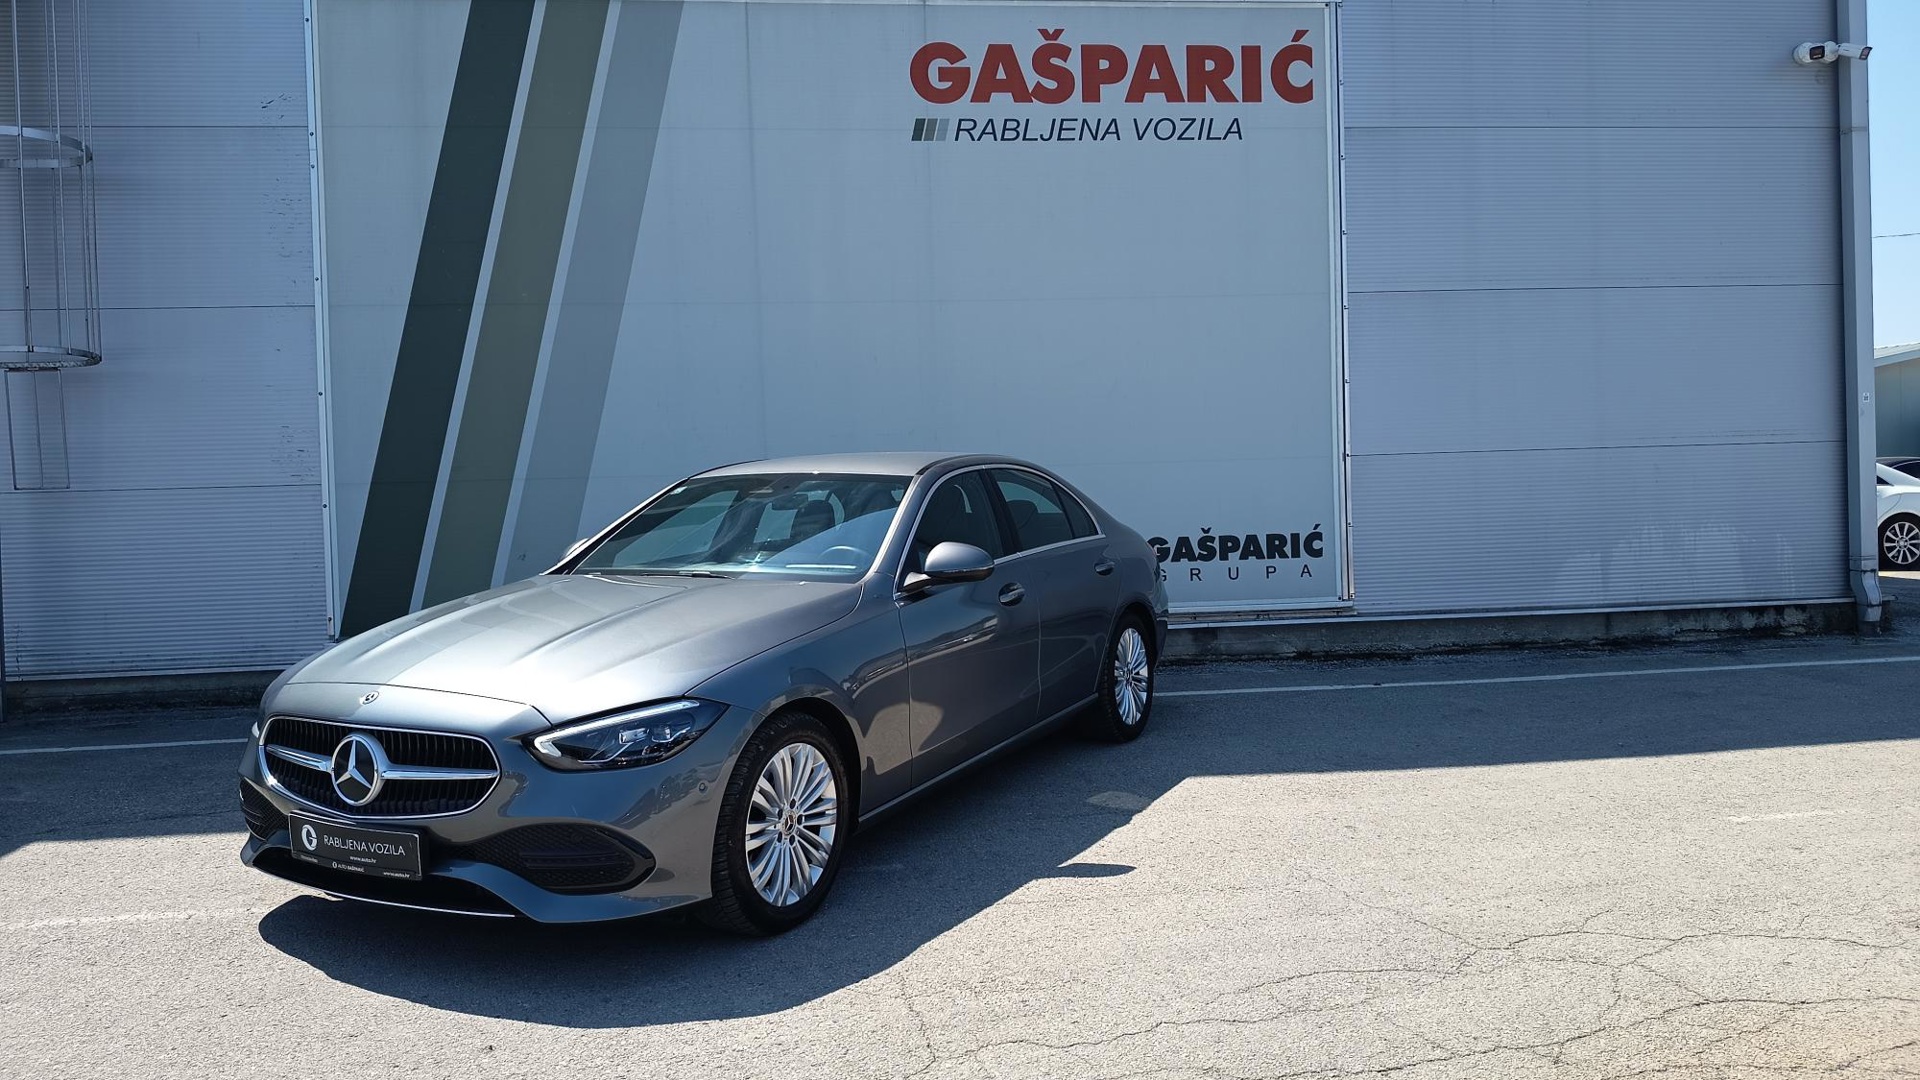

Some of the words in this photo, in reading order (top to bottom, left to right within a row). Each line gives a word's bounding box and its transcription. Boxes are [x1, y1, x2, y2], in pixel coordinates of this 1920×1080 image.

[909, 28, 1313, 104] GAŠPARIĆ
[954, 118, 1121, 142] RABLJENA
[1133, 117, 1243, 141] VOZILA
[1146, 523, 1323, 563] GAŠPARIĆ
[323, 835, 367, 852] RABLJENA
[369, 841, 406, 856] VOZILA
